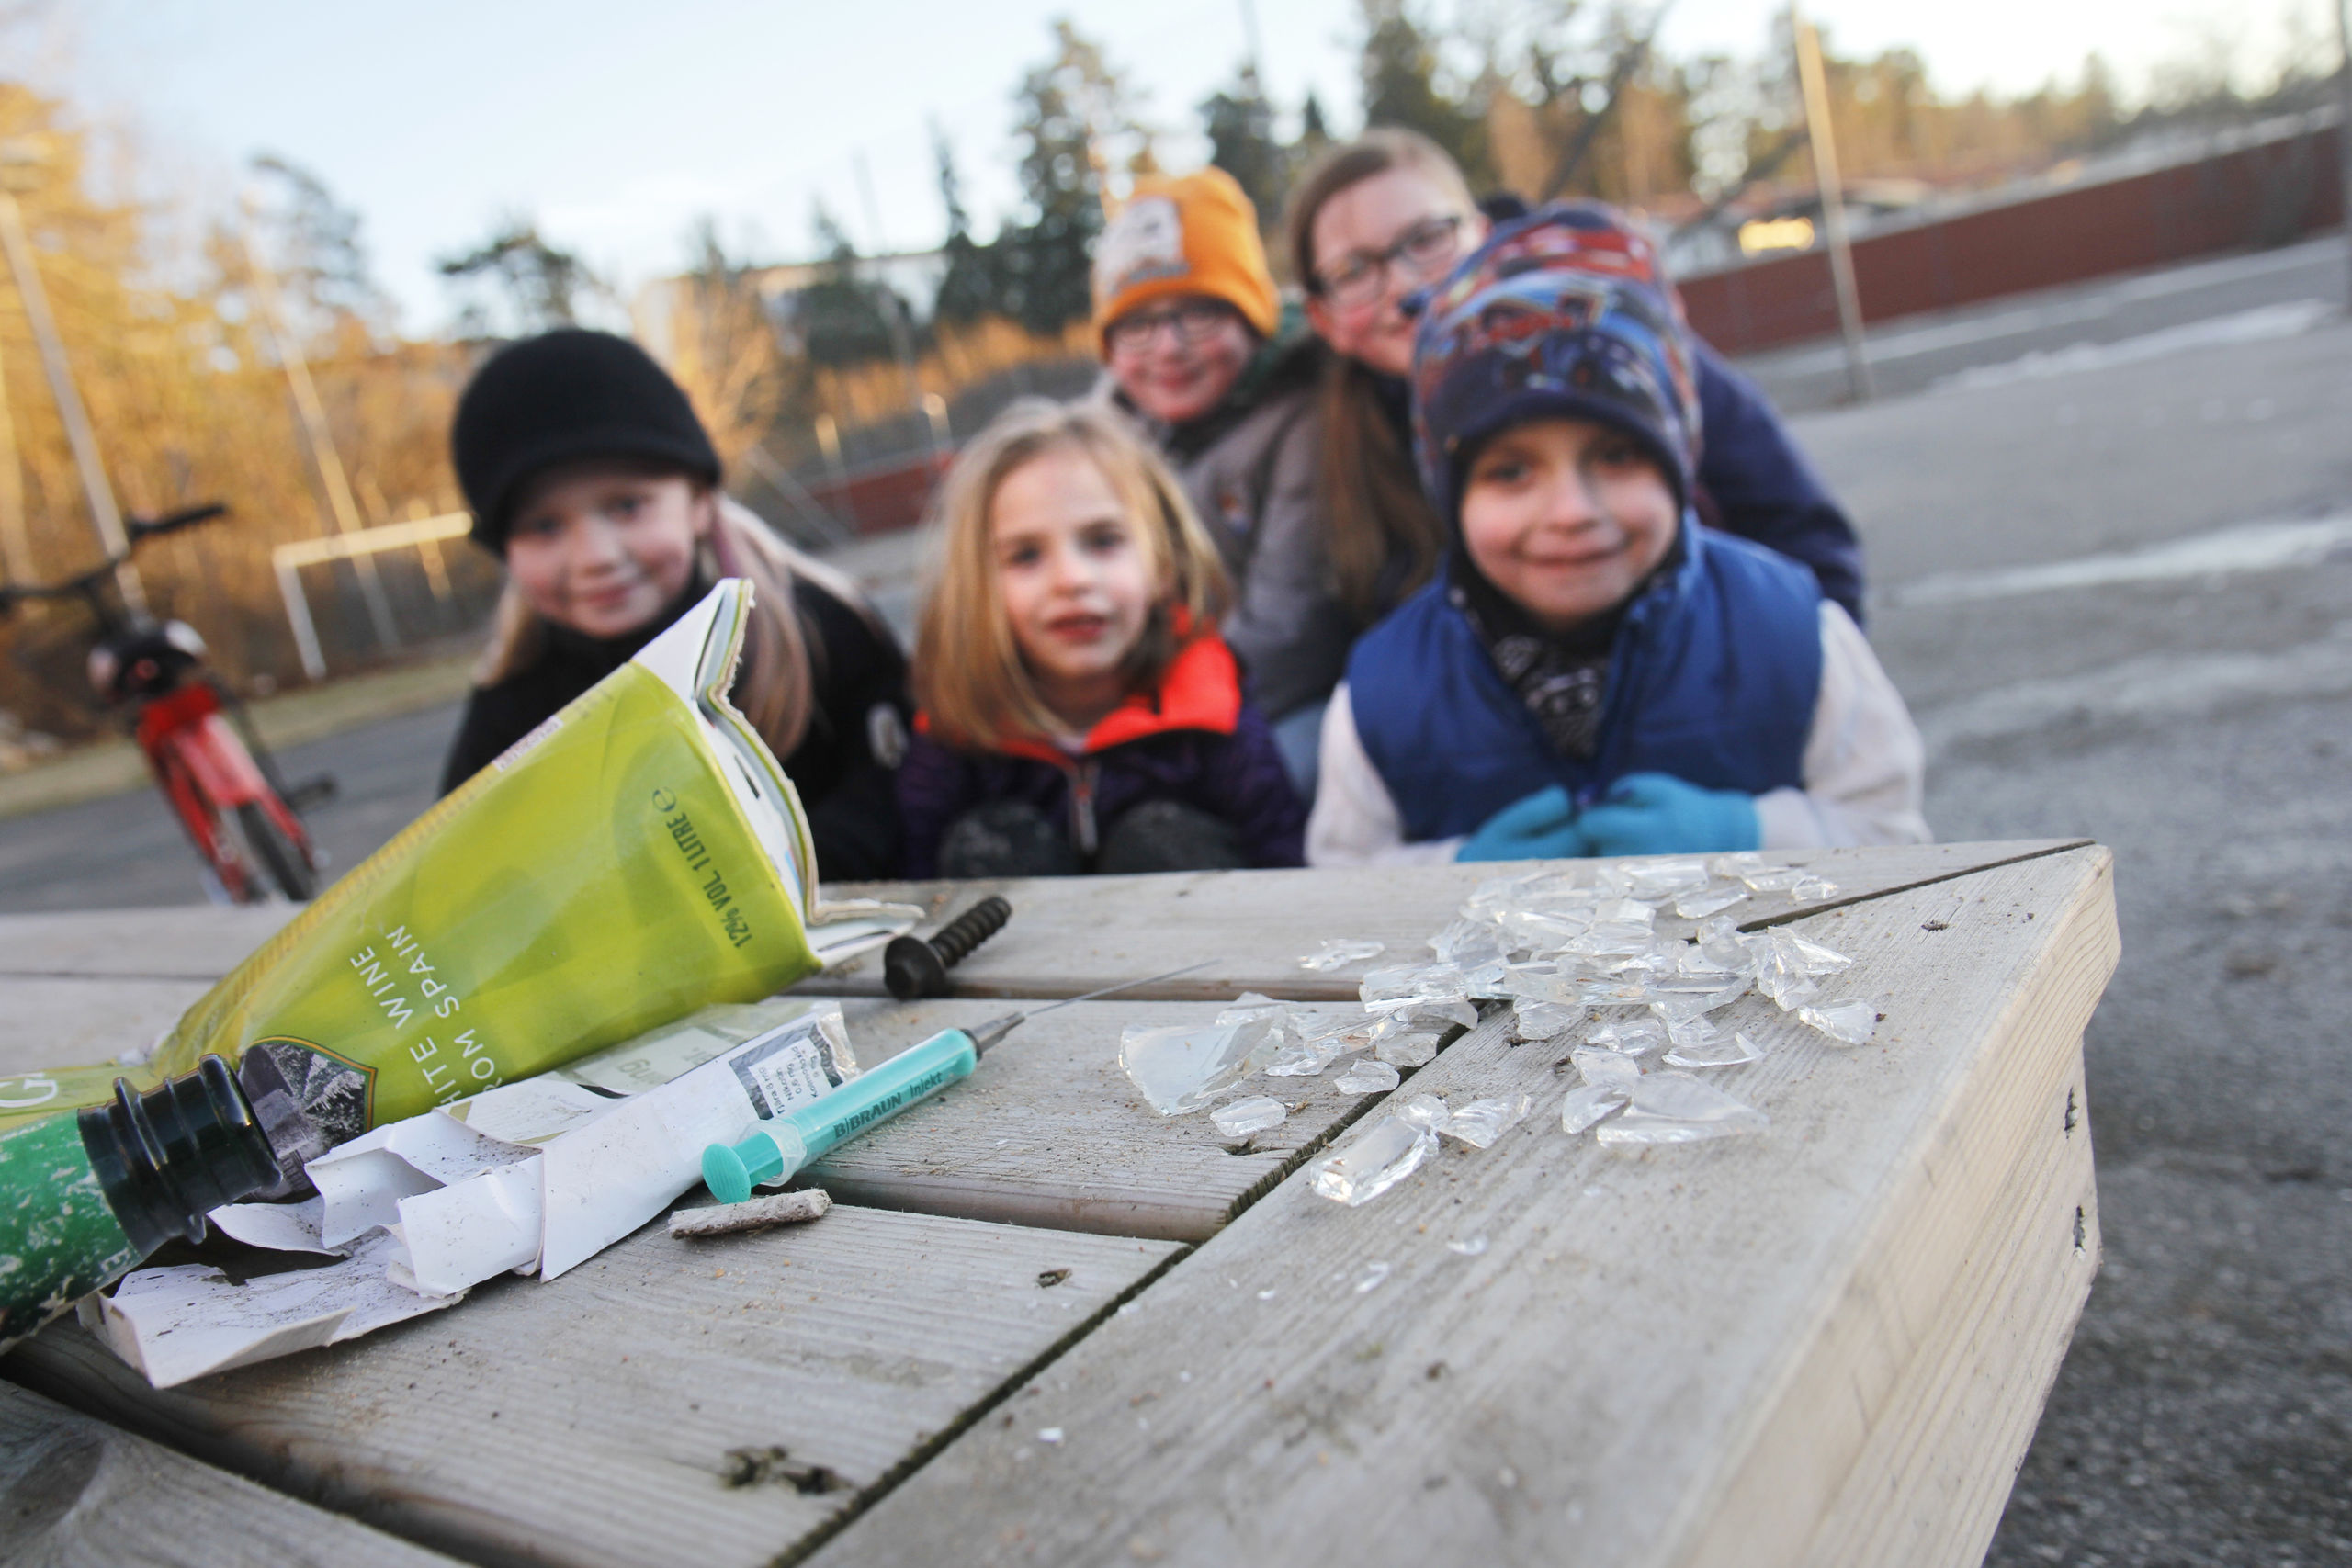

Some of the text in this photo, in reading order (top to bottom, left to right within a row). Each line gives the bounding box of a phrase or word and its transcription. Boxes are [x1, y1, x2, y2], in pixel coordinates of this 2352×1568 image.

[666, 812, 706, 863] LITRE
[692, 857, 711, 872] 1
[721, 908, 752, 948] 12%
[350, 946, 413, 1030] WINE
[386, 925, 459, 1019] SPAIN
[454, 1028, 503, 1092] OM
[776, 1068, 794, 1100] Nikotin
[910, 1071, 943, 1099] Injekt
